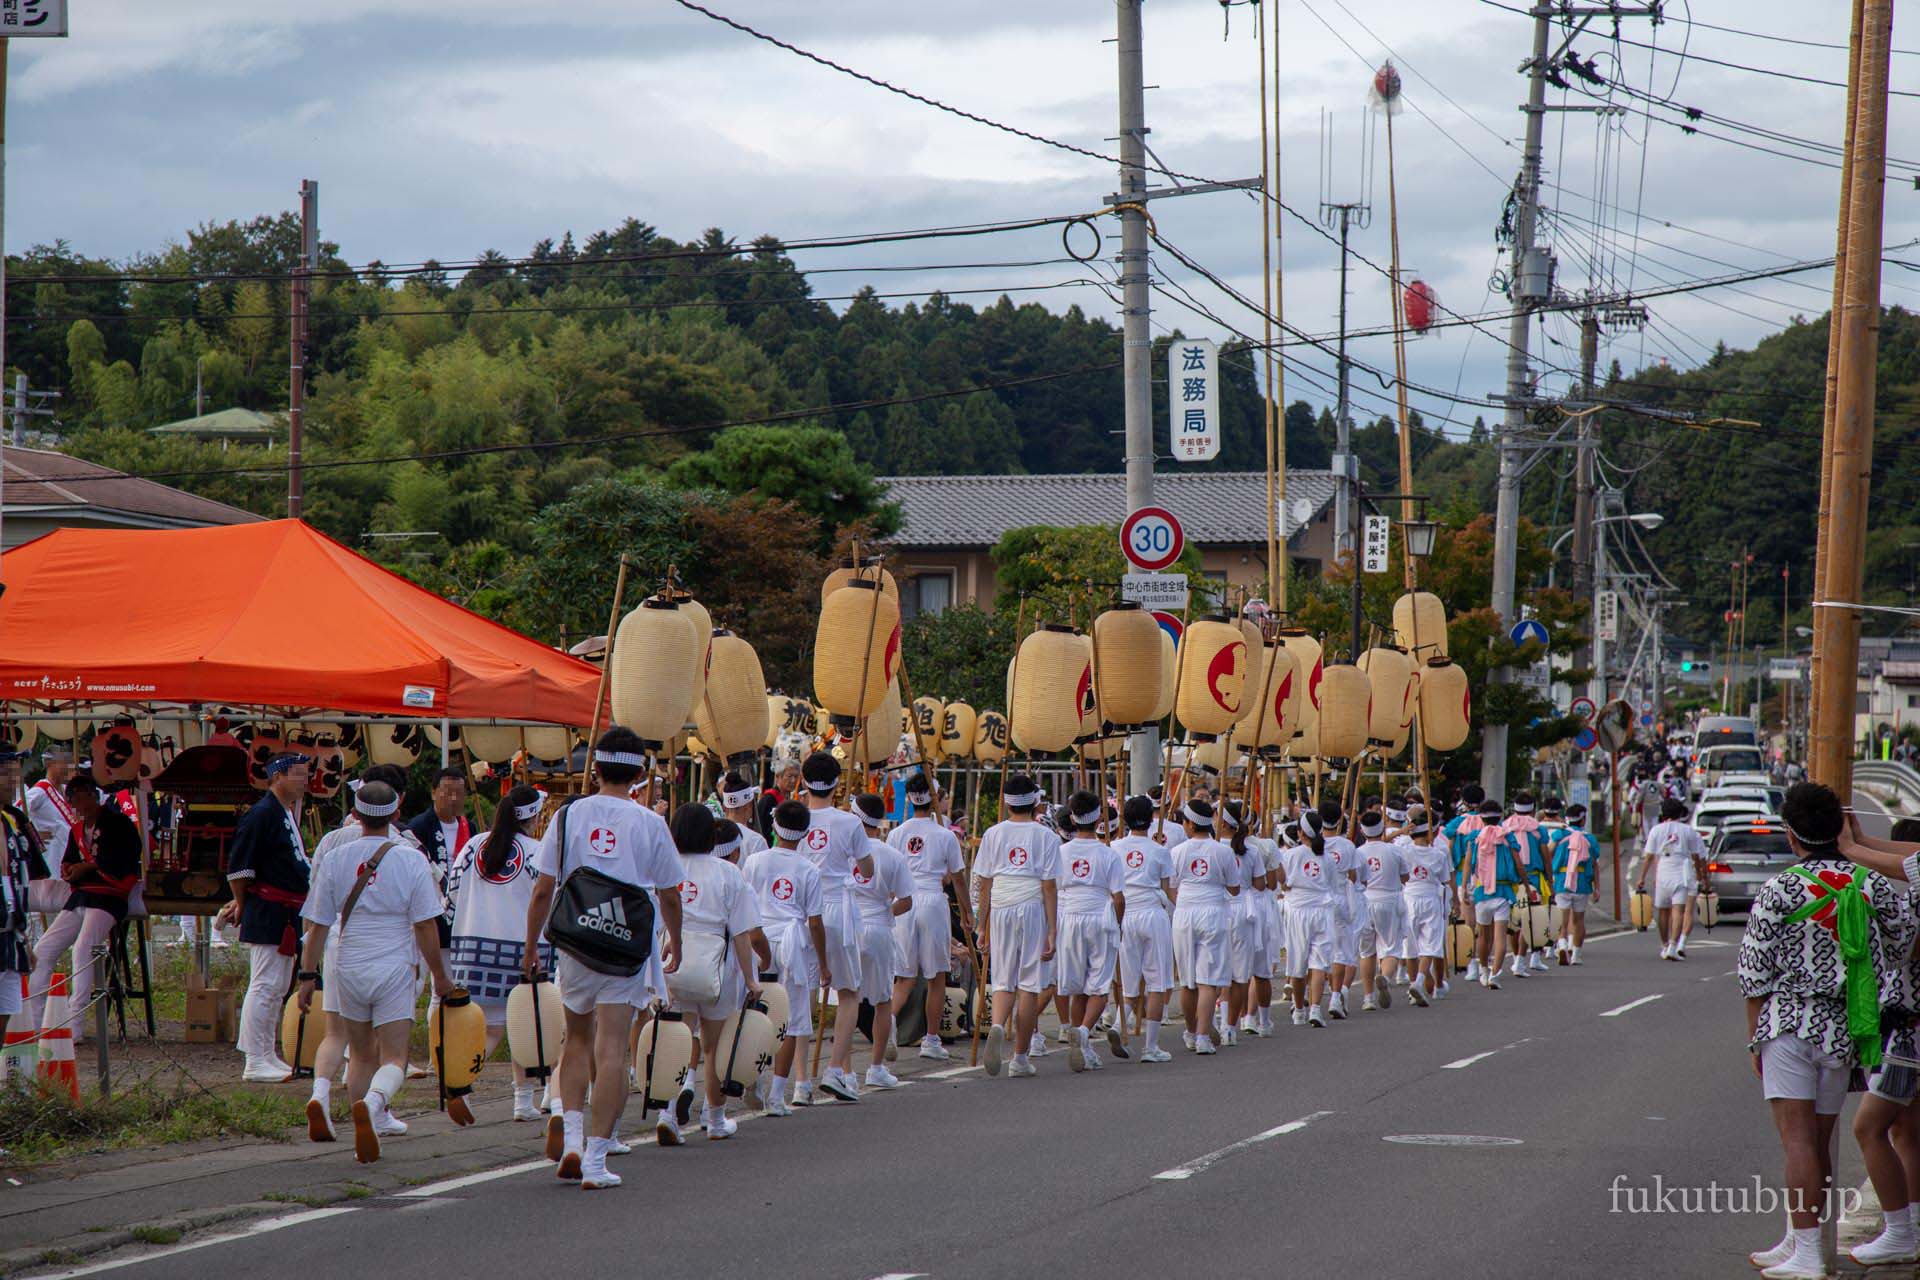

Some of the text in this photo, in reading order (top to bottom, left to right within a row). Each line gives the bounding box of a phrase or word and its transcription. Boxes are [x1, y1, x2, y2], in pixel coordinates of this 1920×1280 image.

[1182, 346, 1206, 433] 法務局
[1179, 438, 1212, 447] 手前信号
[1134, 525, 1170, 553] 30
[1367, 518, 1380, 570] 角屋米店
[1126, 581, 1185, 593] 中心市街地全域
[577, 914, 632, 941] adidas
